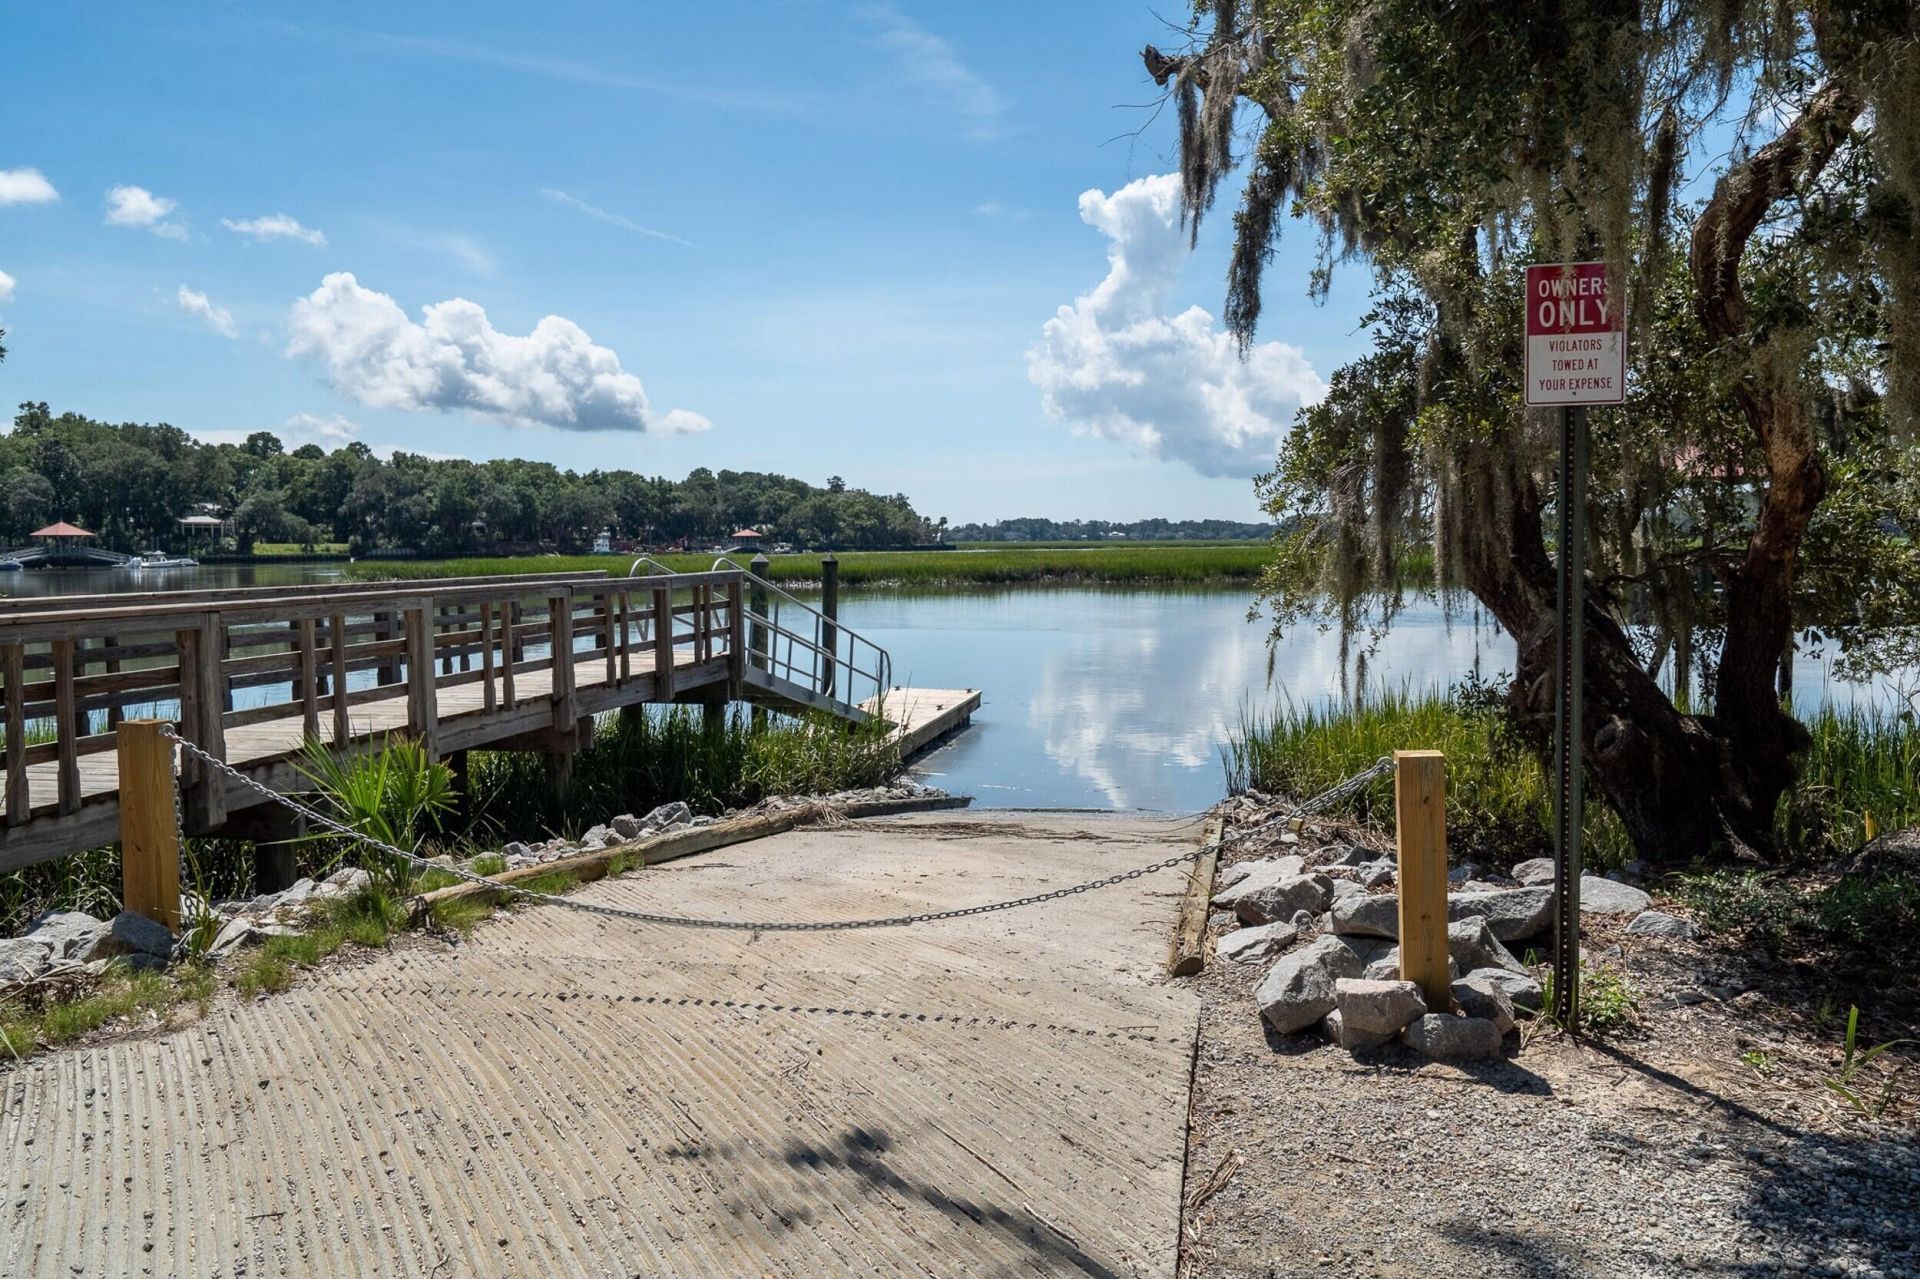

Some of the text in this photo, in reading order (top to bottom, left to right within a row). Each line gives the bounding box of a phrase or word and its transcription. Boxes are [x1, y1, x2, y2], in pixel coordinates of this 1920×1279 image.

[1539, 299, 1609, 327] ONLY
[1549, 340, 1602, 352] VIOLATORS
[1552, 359, 1599, 371] TOWED AT
[1539, 377, 1612, 390] YOUR EXPENSE
